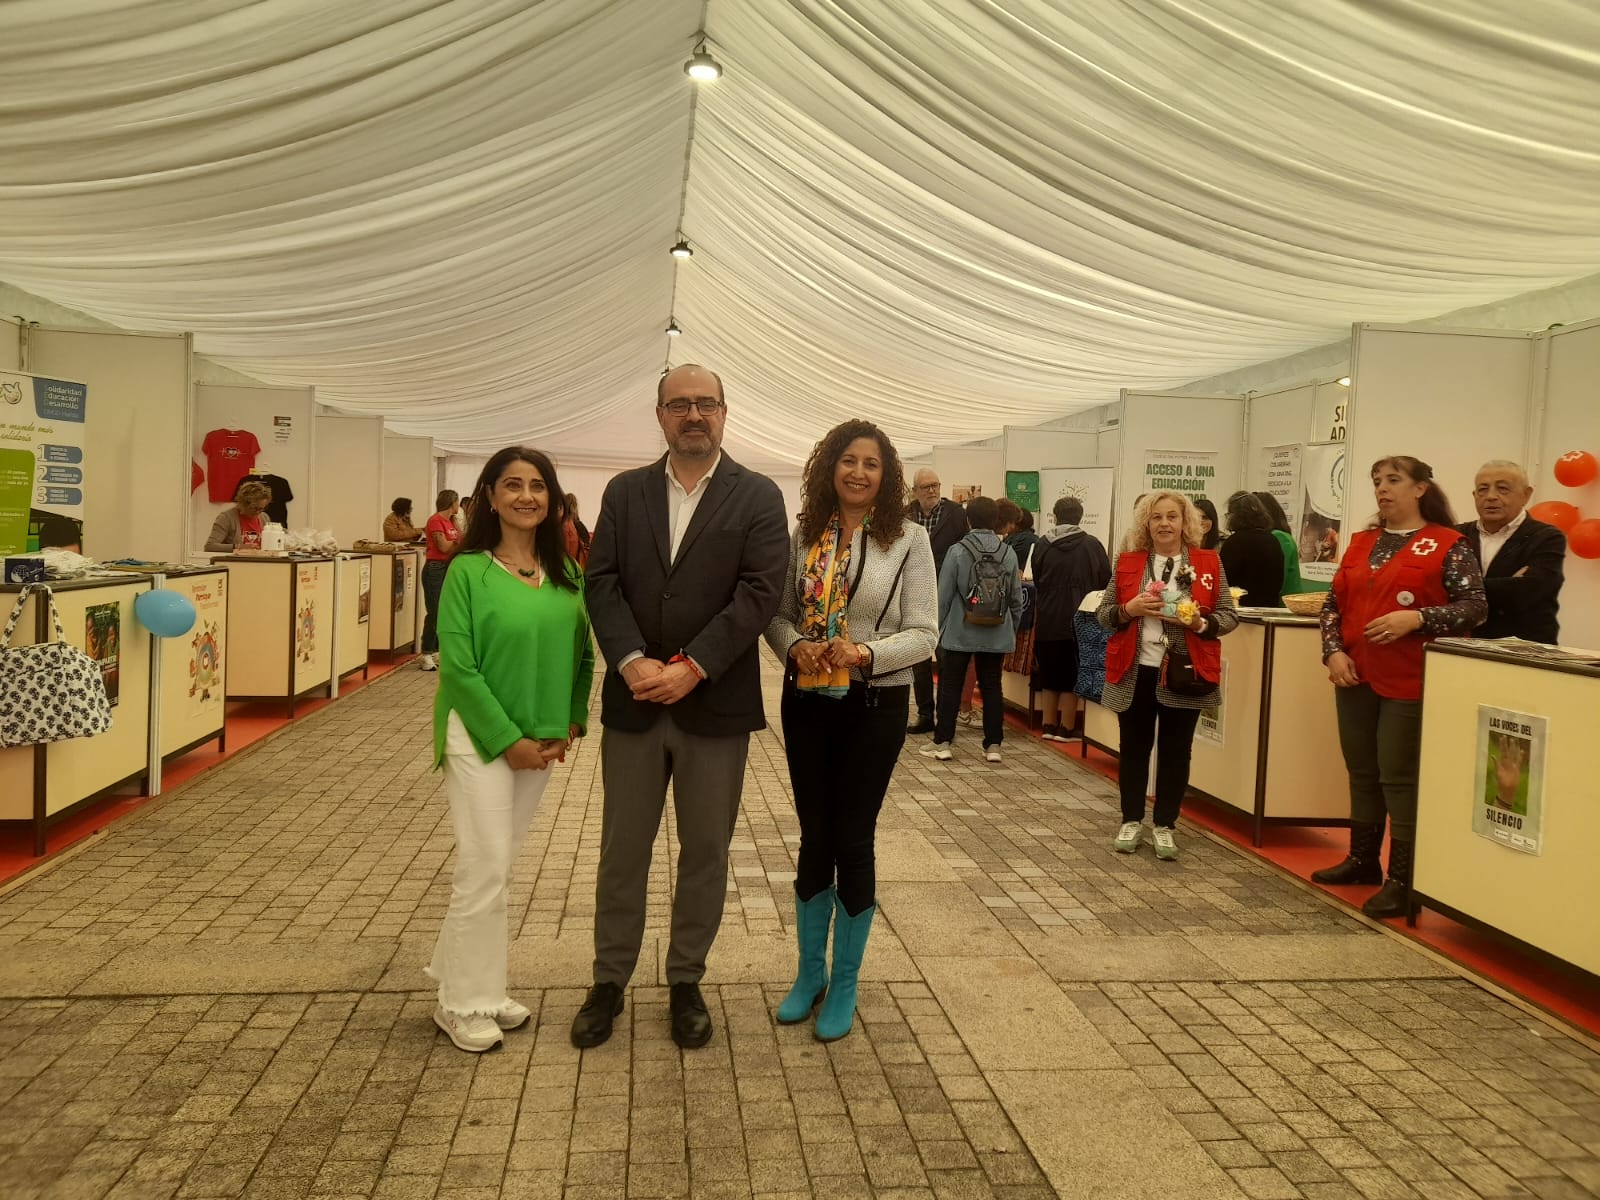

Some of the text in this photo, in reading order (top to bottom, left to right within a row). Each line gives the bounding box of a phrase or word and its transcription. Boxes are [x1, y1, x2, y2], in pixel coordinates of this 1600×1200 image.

[37, 466, 49, 483] 2
[1146, 463, 1215, 478] ACCESO A UNA
[1151, 476, 1205, 491] EDUCACIÓN
[37, 486, 48, 504] 3
[1490, 716, 1532, 737] LAS VOCES DEL
[1486, 807, 1523, 830] SILENCIO
